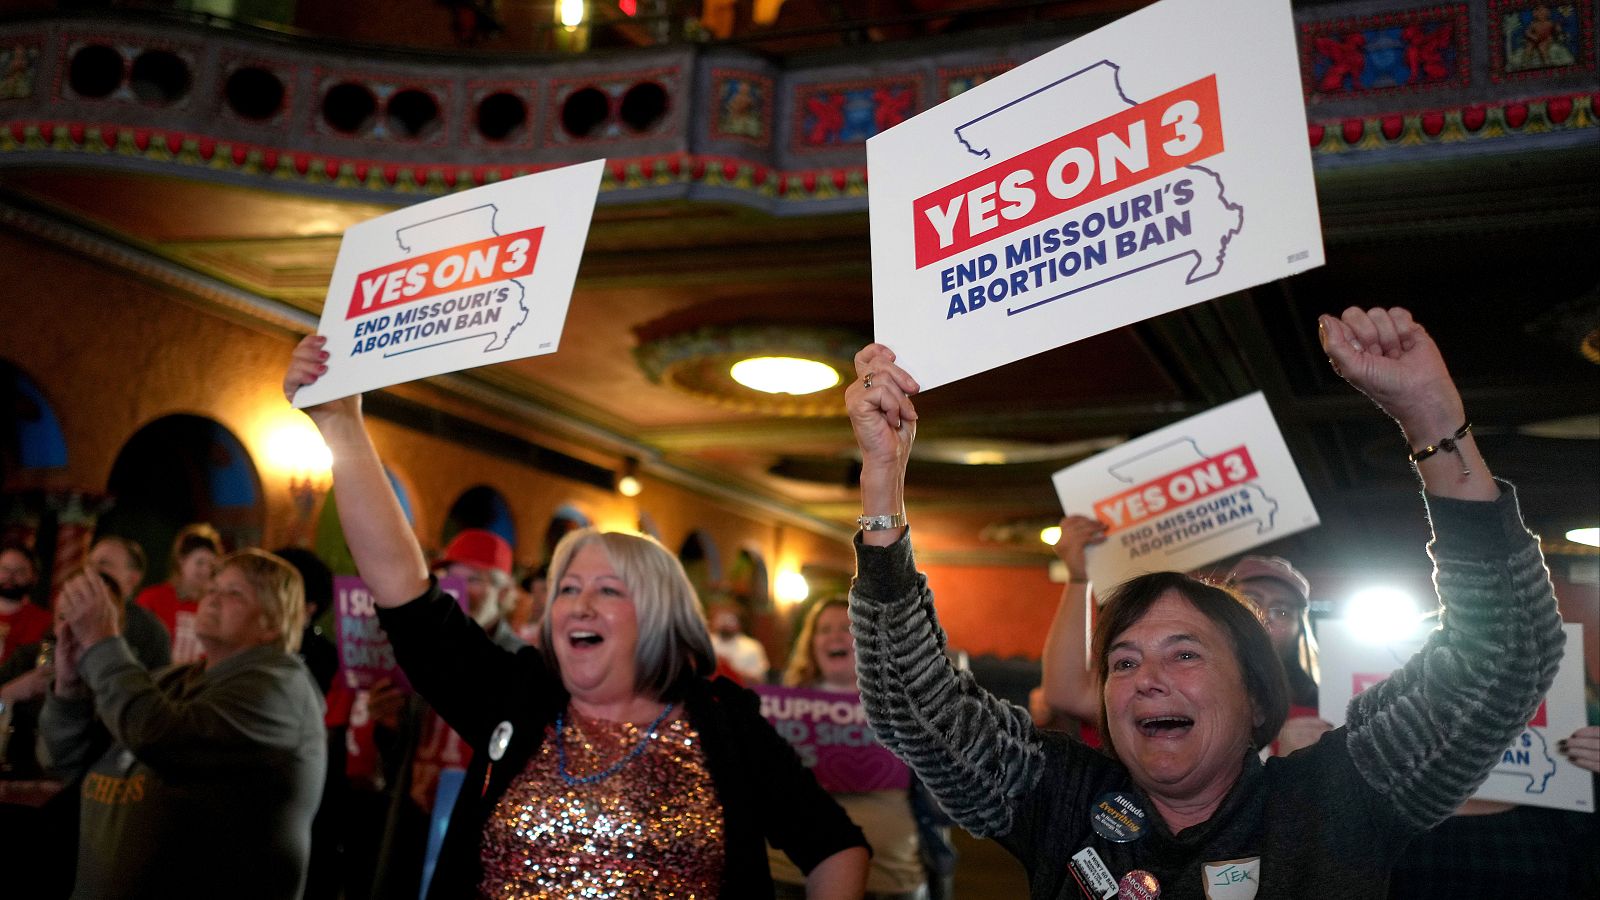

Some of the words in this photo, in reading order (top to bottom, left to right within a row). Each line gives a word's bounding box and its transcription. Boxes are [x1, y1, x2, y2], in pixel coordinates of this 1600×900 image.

[925, 168, 1036, 249] YES
[1045, 119, 1149, 201] ON
[1161, 99, 1203, 156] 3
[940, 247, 998, 293] END
[1006, 178, 1195, 269] MISSOURI'S
[361, 264, 429, 309] YES
[433, 246, 498, 288] ON
[502, 241, 530, 273] 3
[946, 244, 1107, 320] ABORTION
[1116, 210, 1192, 260] BAN
[350, 320, 450, 357] ABORTION
[454, 306, 502, 330] BAN
[355, 317, 390, 338] END
[393, 287, 509, 329] MISSOURI'S
[1103, 493, 1166, 527] YES
[1168, 467, 1222, 502] ON
[1224, 455, 1247, 481] 3
[1120, 528, 1153, 547] END
[1156, 488, 1251, 536] MISSOURI'S
[1129, 519, 1214, 560] ABORTION
[1217, 503, 1254, 527] BAN
[760, 695, 867, 726] SUPPO
[1503, 750, 1530, 765] AN
[1099, 802, 1140, 832] Everything
[1114, 795, 1145, 818] Attitude
[1126, 876, 1153, 900] ABORTIO
